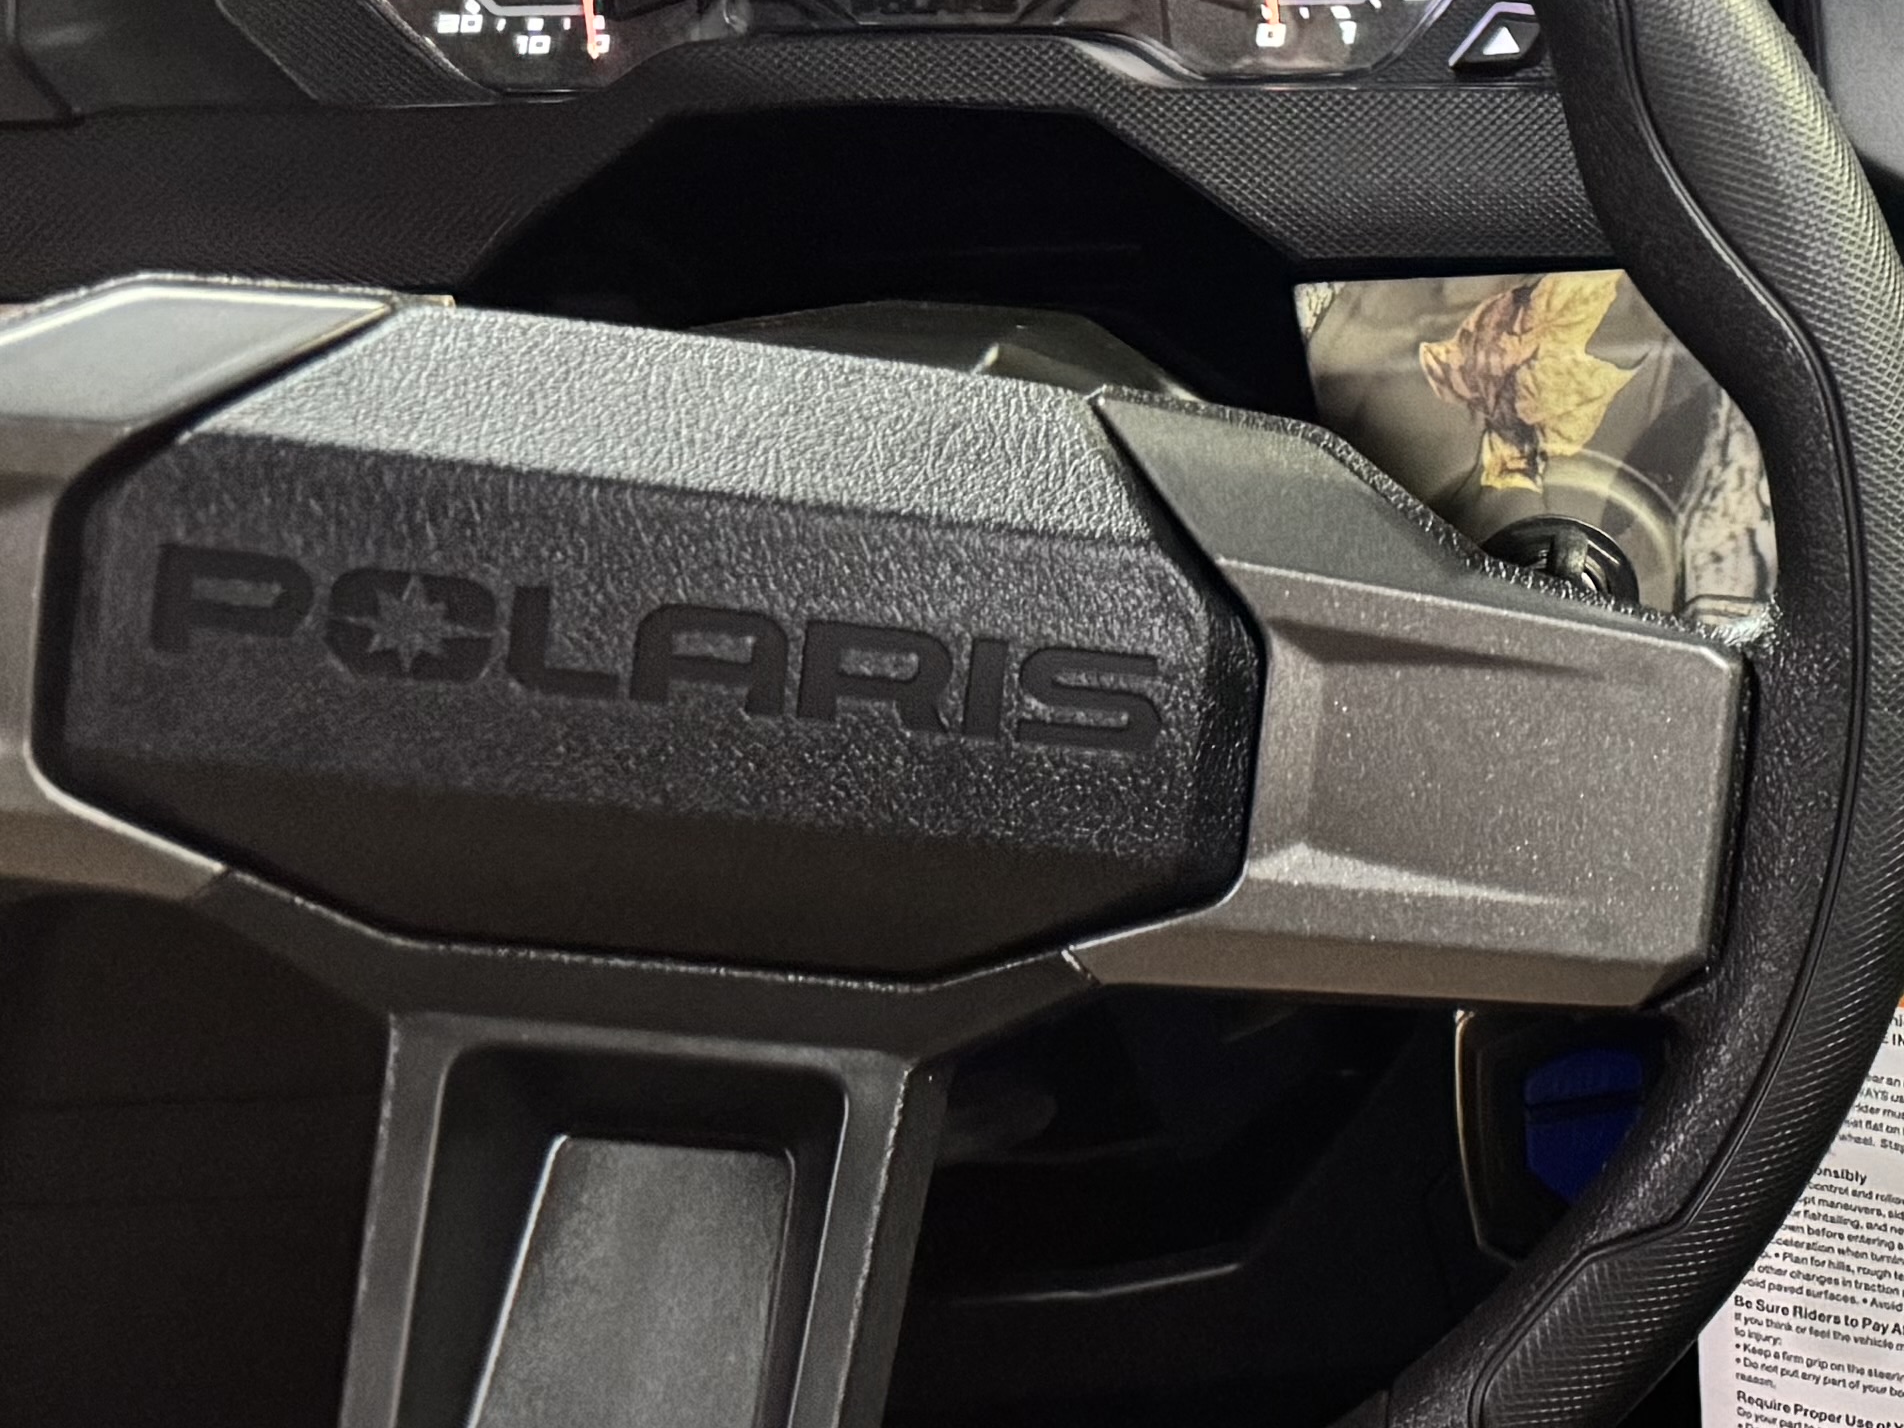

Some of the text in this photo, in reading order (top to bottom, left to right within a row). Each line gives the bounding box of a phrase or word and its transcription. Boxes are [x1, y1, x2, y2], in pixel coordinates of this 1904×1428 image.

[516, 35, 552, 55] 10
[150, 541, 1164, 752] POLARIS
[1756, 1299, 1789, 1316] Sure
[1793, 1306, 1841, 1324] Riders
[1845, 1315, 1858, 1328] to
[1862, 1317, 1889, 1334] Pay
[1737, 1391, 1791, 1413] Require
[1794, 1404, 1841, 1423] Proper
[1846, 1414, 1873, 1428] Use
